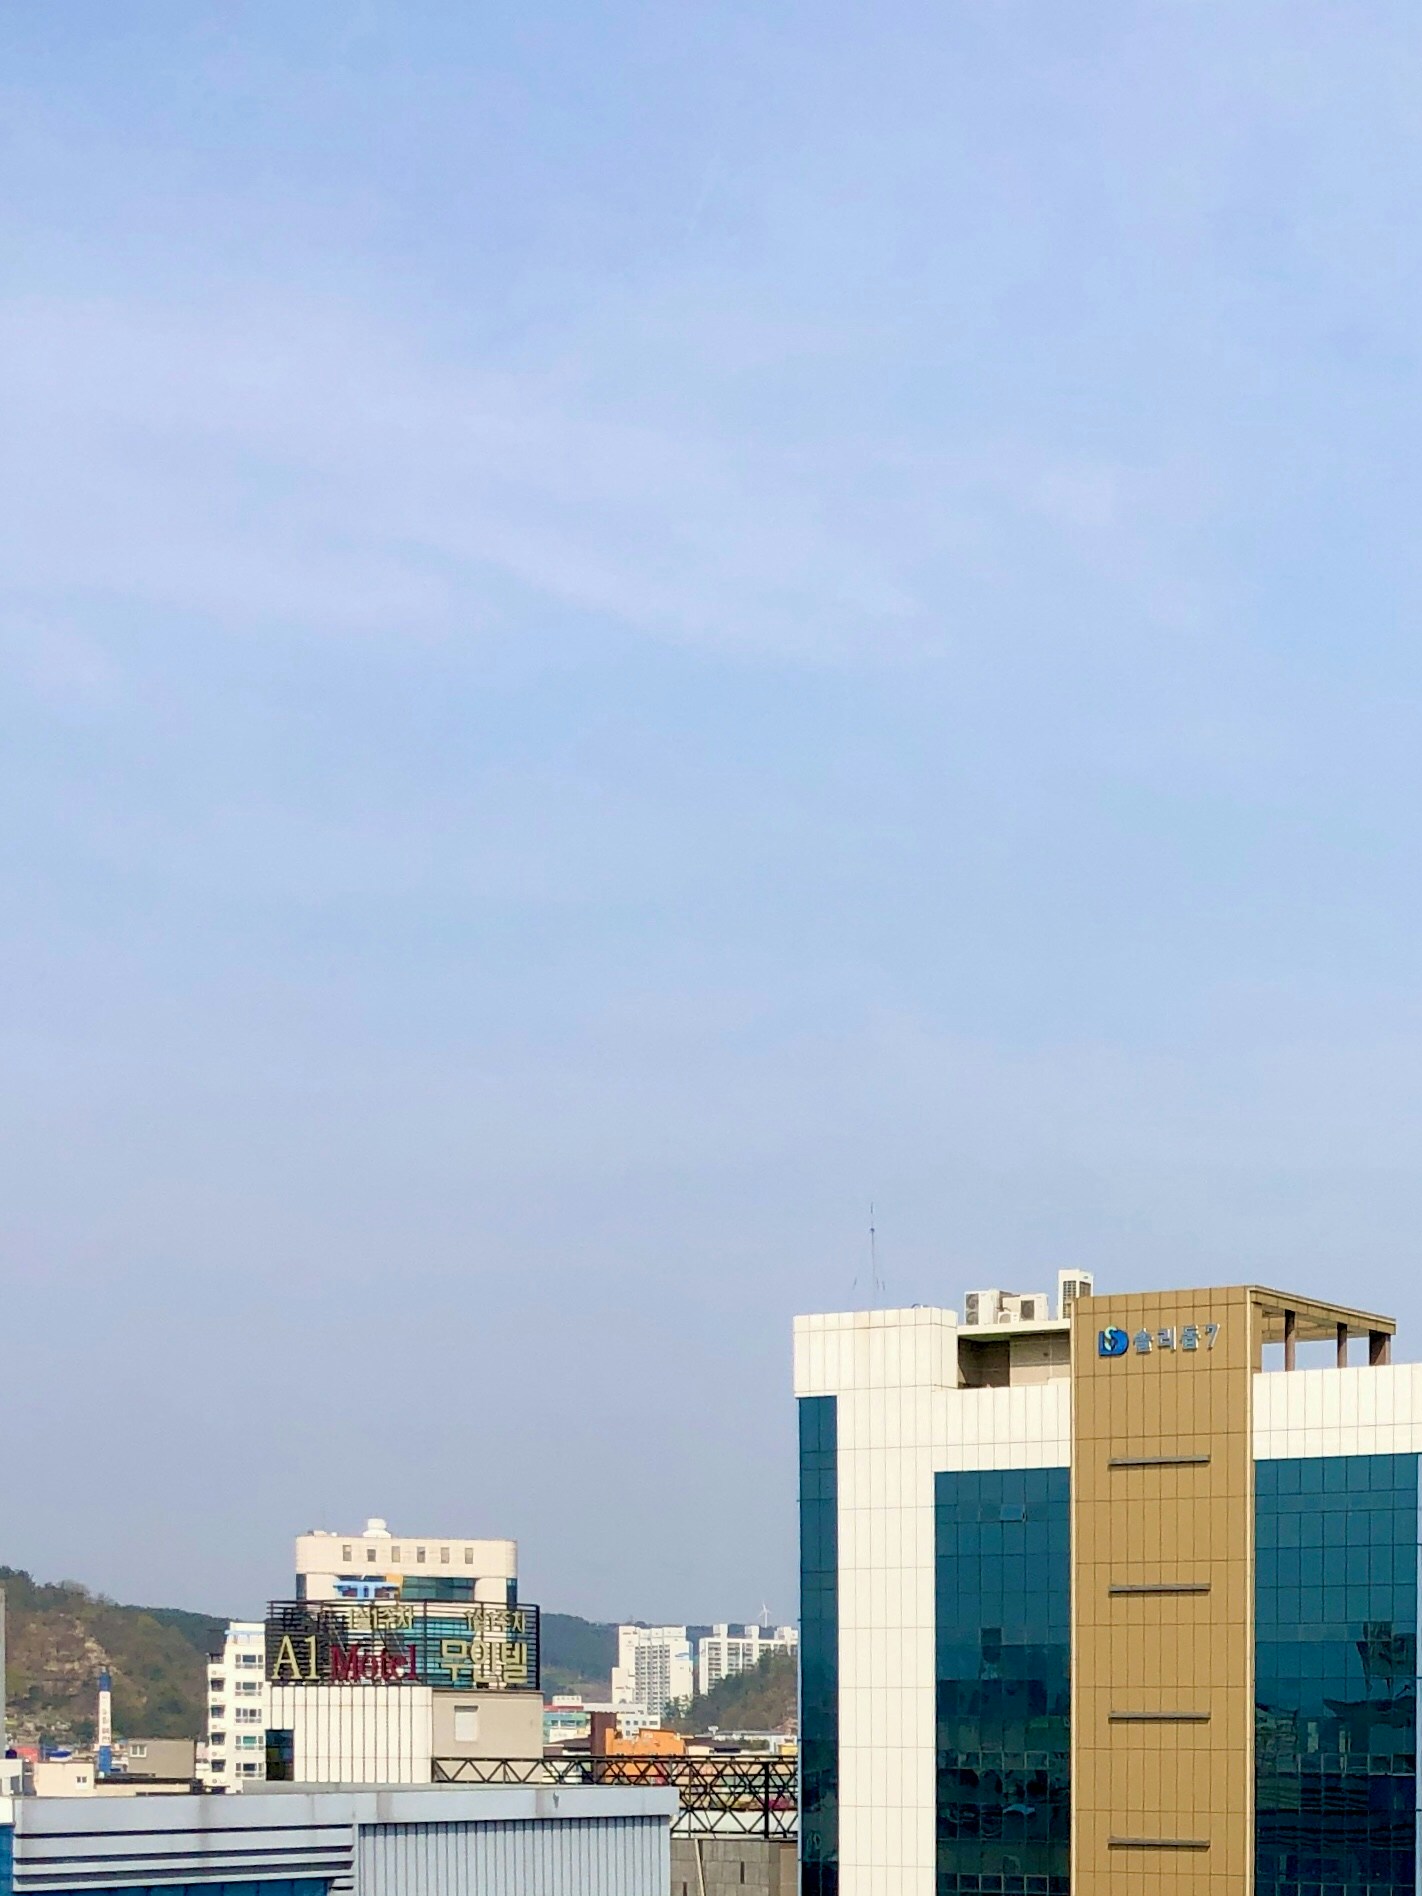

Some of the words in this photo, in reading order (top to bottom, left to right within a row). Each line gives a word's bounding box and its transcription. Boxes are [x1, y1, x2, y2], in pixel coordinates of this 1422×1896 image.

[271, 1634, 321, 1680] A1
[328, 1643, 418, 1682] Motel
[441, 1639, 528, 1684] 무인텔
